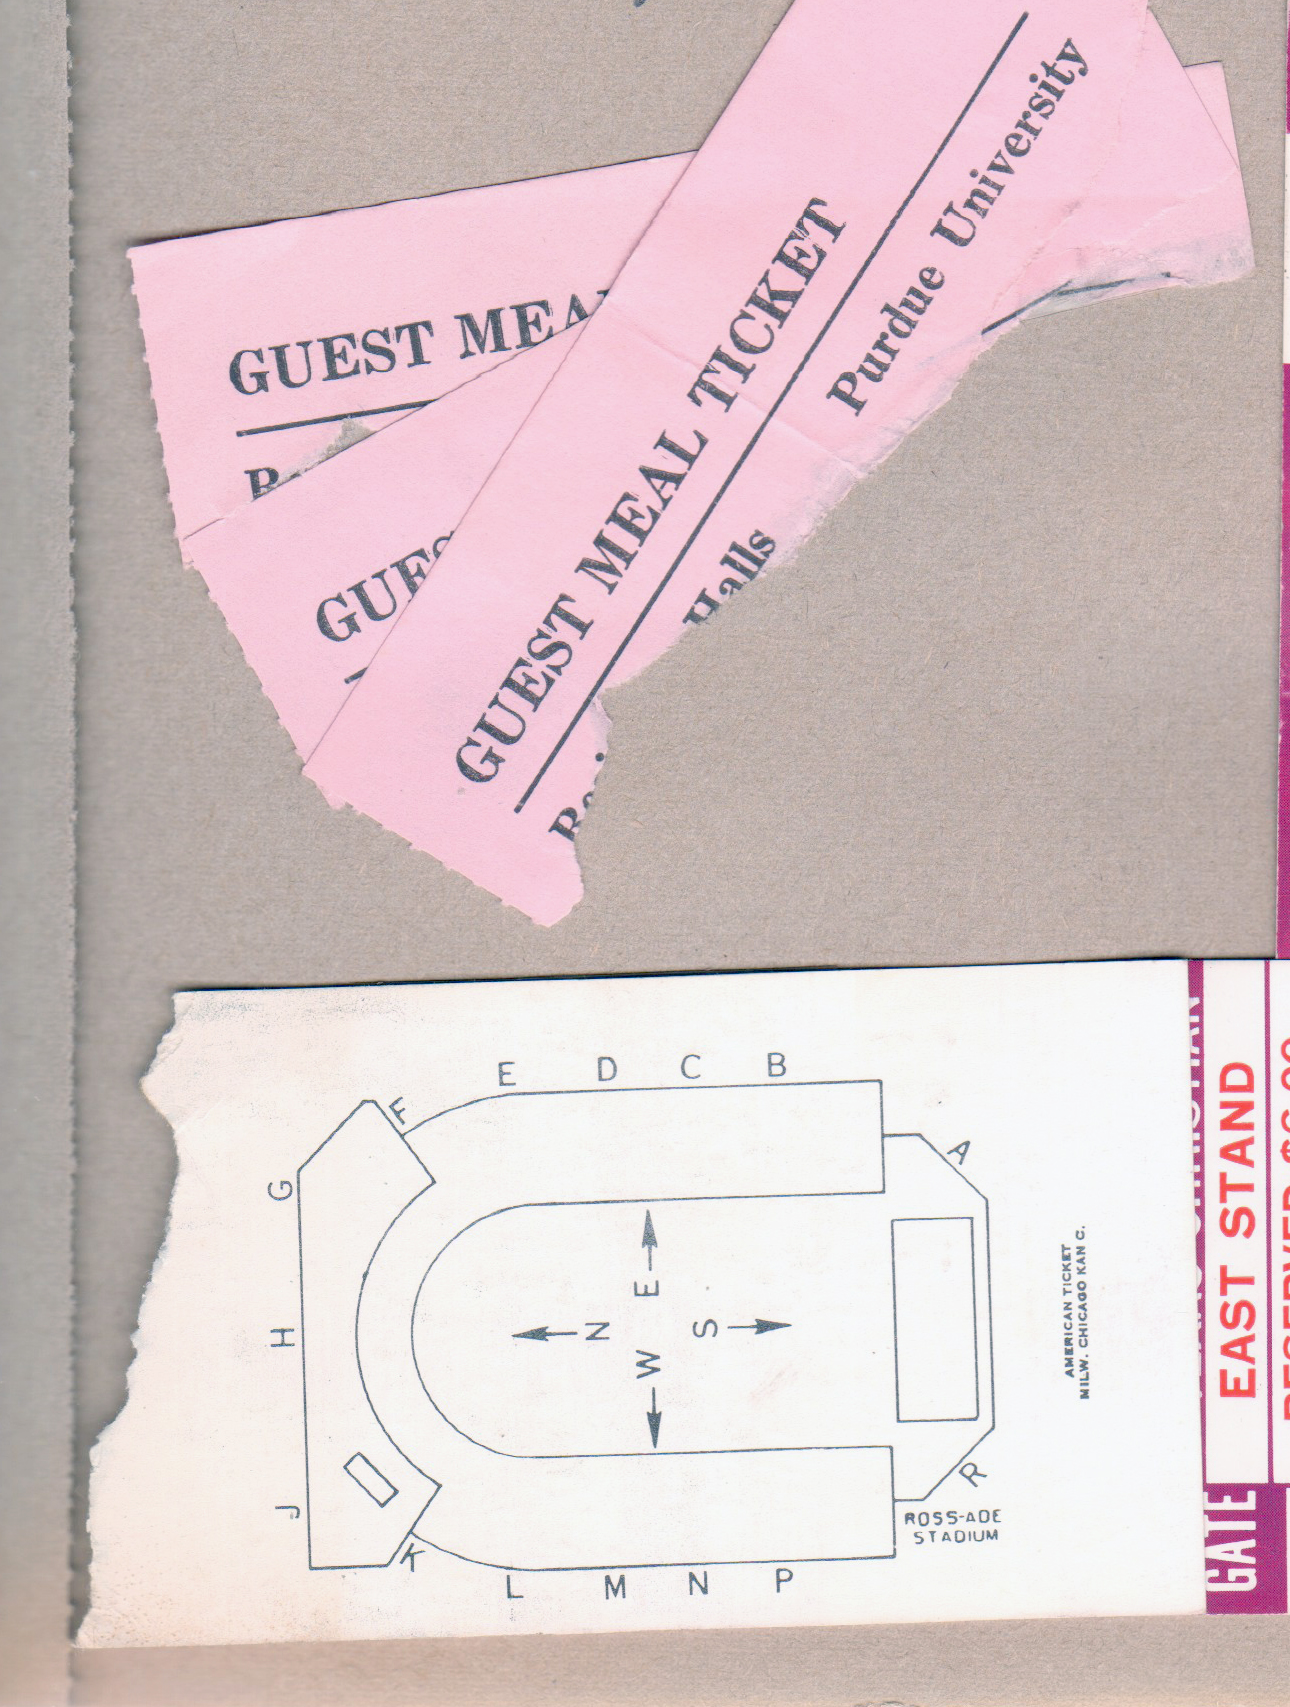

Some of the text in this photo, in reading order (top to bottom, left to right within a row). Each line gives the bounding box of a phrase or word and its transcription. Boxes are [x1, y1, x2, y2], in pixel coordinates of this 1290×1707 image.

[826, 37, 1089, 416] Purdue University
[229, 289, 610, 396] GUEST MEA
[456, 592, 595, 783] GUEST
[574, 429, 709, 595] MEAL
[686, 196, 846, 413] TICKET
[499, 1062, 515, 1086] E
[598, 1057, 616, 1081] D
[681, 1055, 700, 1079] C
[768, 1053, 786, 1077] B
[389, 1097, 411, 1125] F
[946, 1140, 973, 1165] A
[268, 1181, 292, 1201] G
[1220, 1063, 1255, 1397] EAST STAND
[1075, 1246, 1086, 1275] KAN
[634, 1281, 659, 1296] E
[1061, 1244, 1075, 1379] AMERICAN TICKET
[1076, 1280, 1088, 1349] CHICAGO
[271, 1329, 294, 1347] H
[586, 1323, 609, 1340] N
[693, 1319, 717, 1337] S
[636, 1350, 660, 1379] W
[1079, 1353, 1090, 1400] MILW.
[958, 1461, 988, 1488] R
[275, 1506, 300, 1518] J
[905, 1510, 1001, 1526] ROSS-ADE
[914, 1530, 997, 1544] STADIUM
[1204, 1490, 1257, 1593] GATE
[400, 1543, 426, 1572] K
[507, 1575, 524, 1599] L
[605, 1575, 625, 1599] M
[689, 1571, 708, 1595] N
[776, 1569, 793, 1592] P
